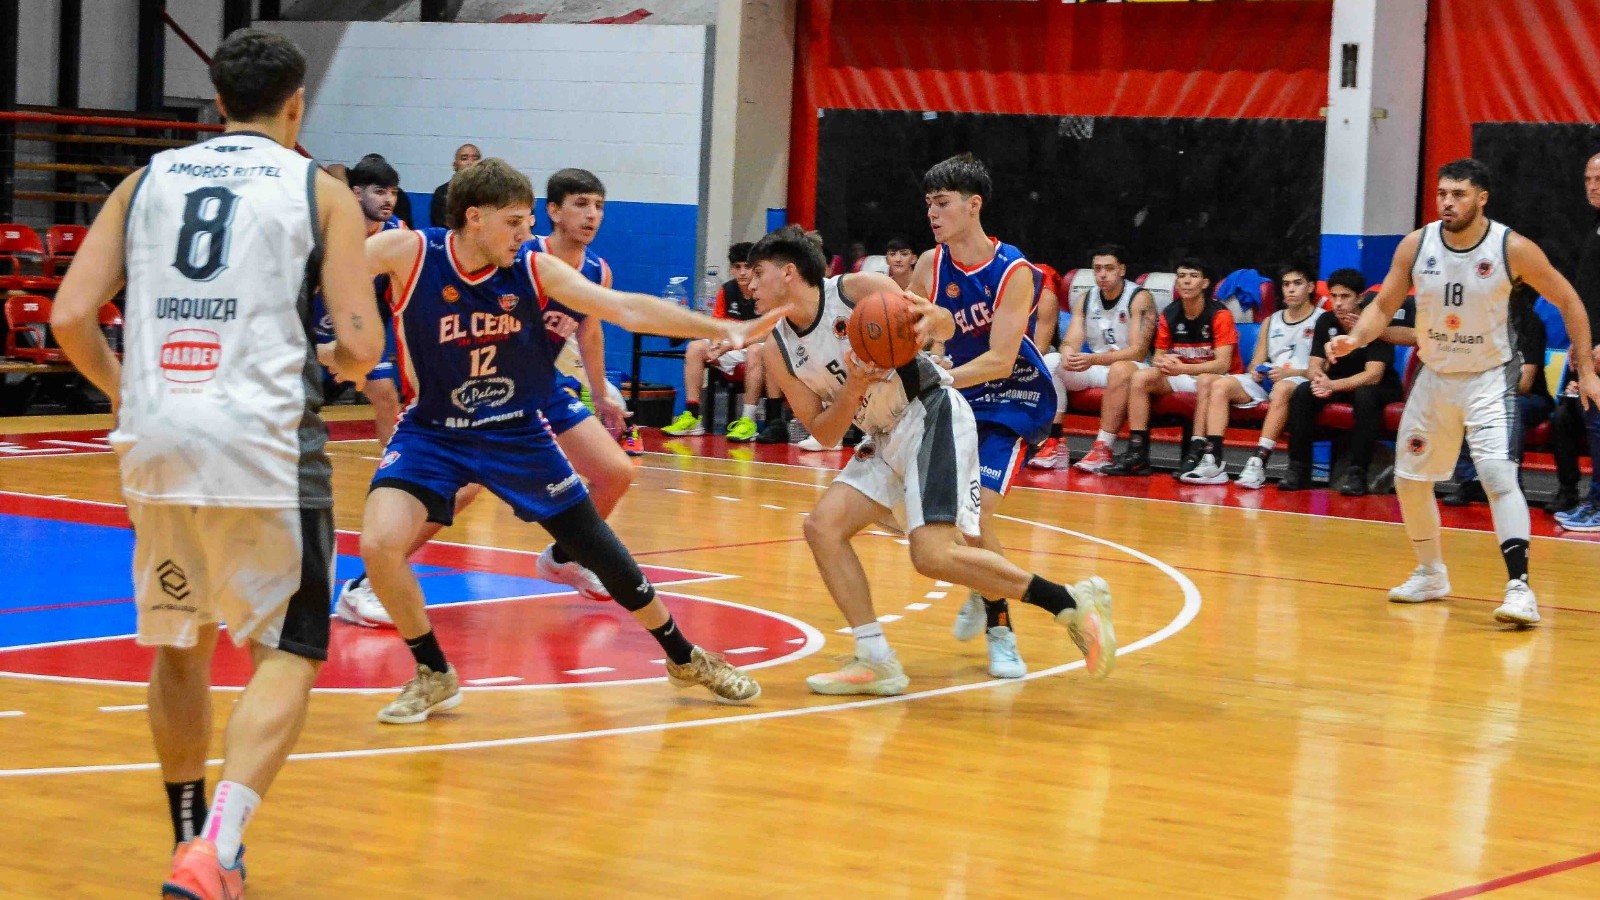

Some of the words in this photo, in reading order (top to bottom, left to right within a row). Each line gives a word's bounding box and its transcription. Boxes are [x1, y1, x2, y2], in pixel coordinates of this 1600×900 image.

[167, 163, 230, 178] AMORÓS
[233, 165, 282, 178] RITTEL
[170, 186, 243, 282] 8
[1444, 282, 1464, 307] 18
[157, 297, 238, 322] URQUIZA
[954, 308, 975, 334] EL
[439, 314, 467, 344] EL
[1427, 328, 1449, 342] San
[1451, 333, 1485, 344] Juan
[469, 345, 497, 377] 12
